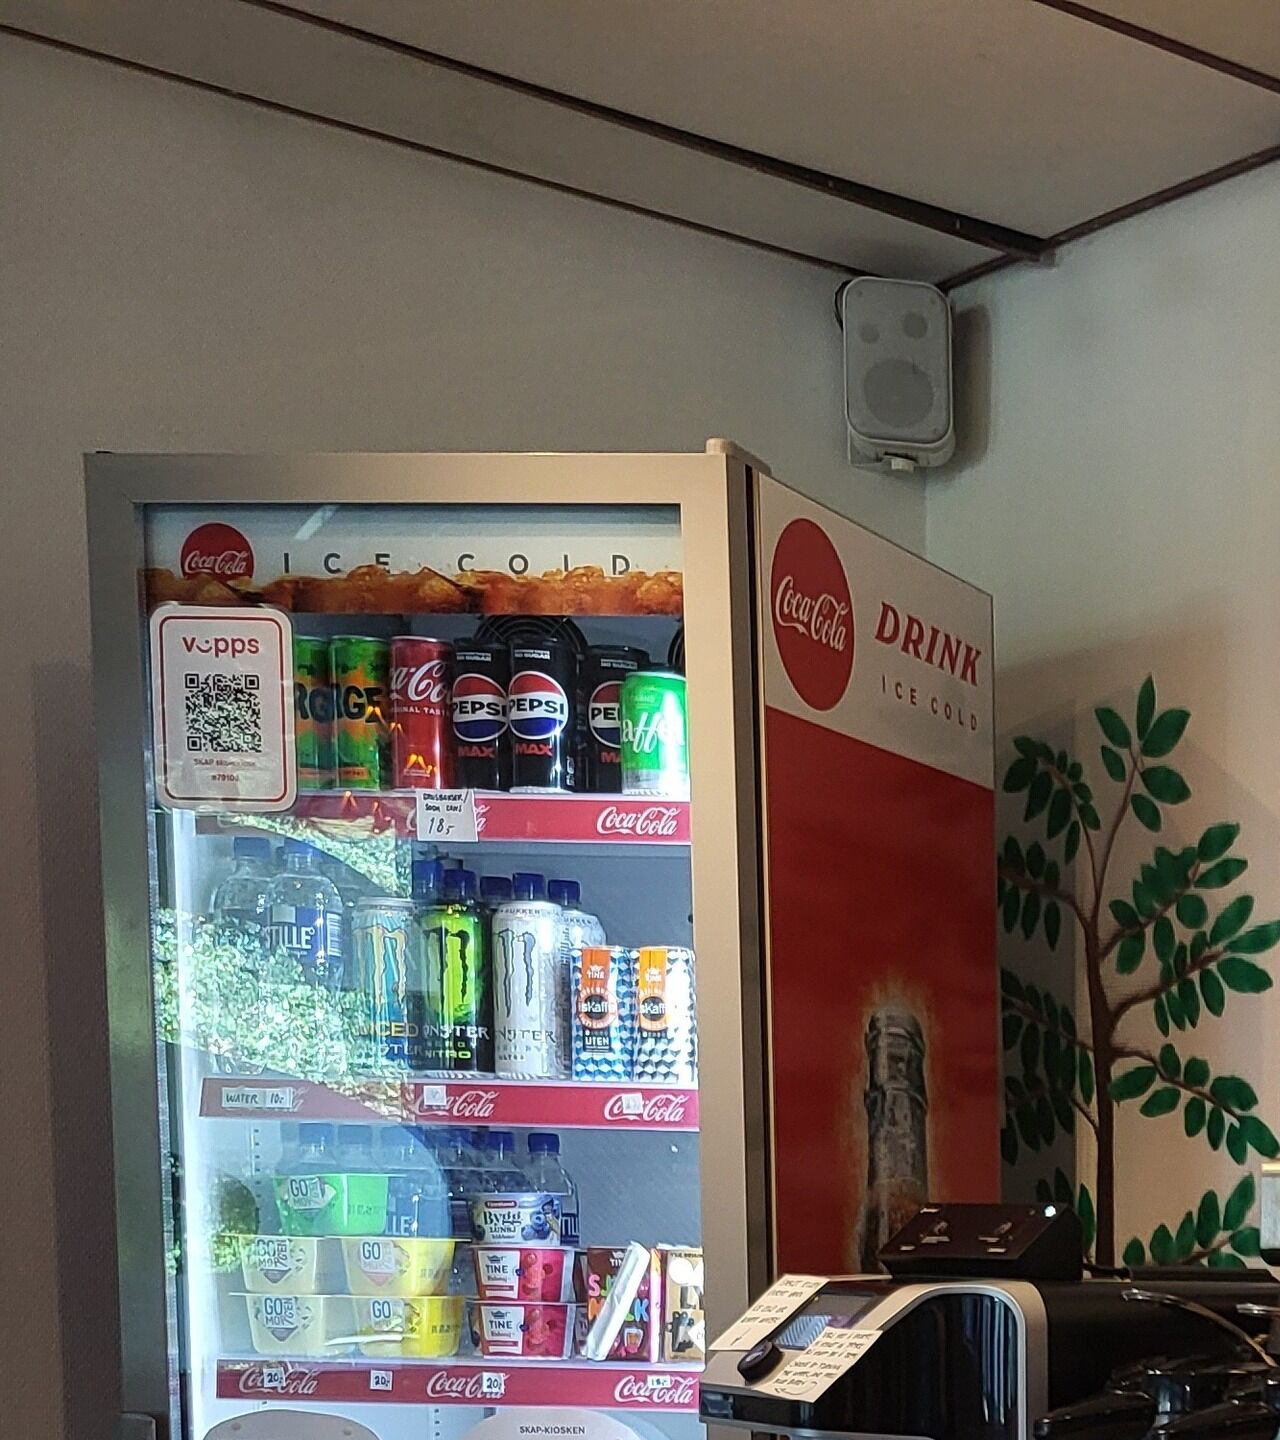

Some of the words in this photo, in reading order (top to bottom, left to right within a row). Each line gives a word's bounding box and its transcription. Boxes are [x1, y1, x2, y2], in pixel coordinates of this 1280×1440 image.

[283, 552, 391, 574] ICE
[775, 575, 849, 652] Coca-Cola
[874, 601, 982, 687] DRINK
[452, 700, 507, 717] PEPSI
[509, 698, 565, 716] PEPSI
[881, 674, 918, 706] ICE
[930, 696, 978, 731] COLD
[457, 744, 496, 758] MAX
[515, 742, 553, 757] MAX
[596, 805, 681, 837] Coca-Cola
[225, 1092, 260, 1105] WATER
[290, 1179, 309, 1197] GO
[362, 1241, 381, 1260] GO
[485, 1264, 508, 1275] TINE
[264, 1297, 284, 1316] GO
[372, 1300, 391, 1319] GO
[488, 1320, 513, 1330] TINE
[519, 1424, 586, 1436] SKAP-KIOSKEN
